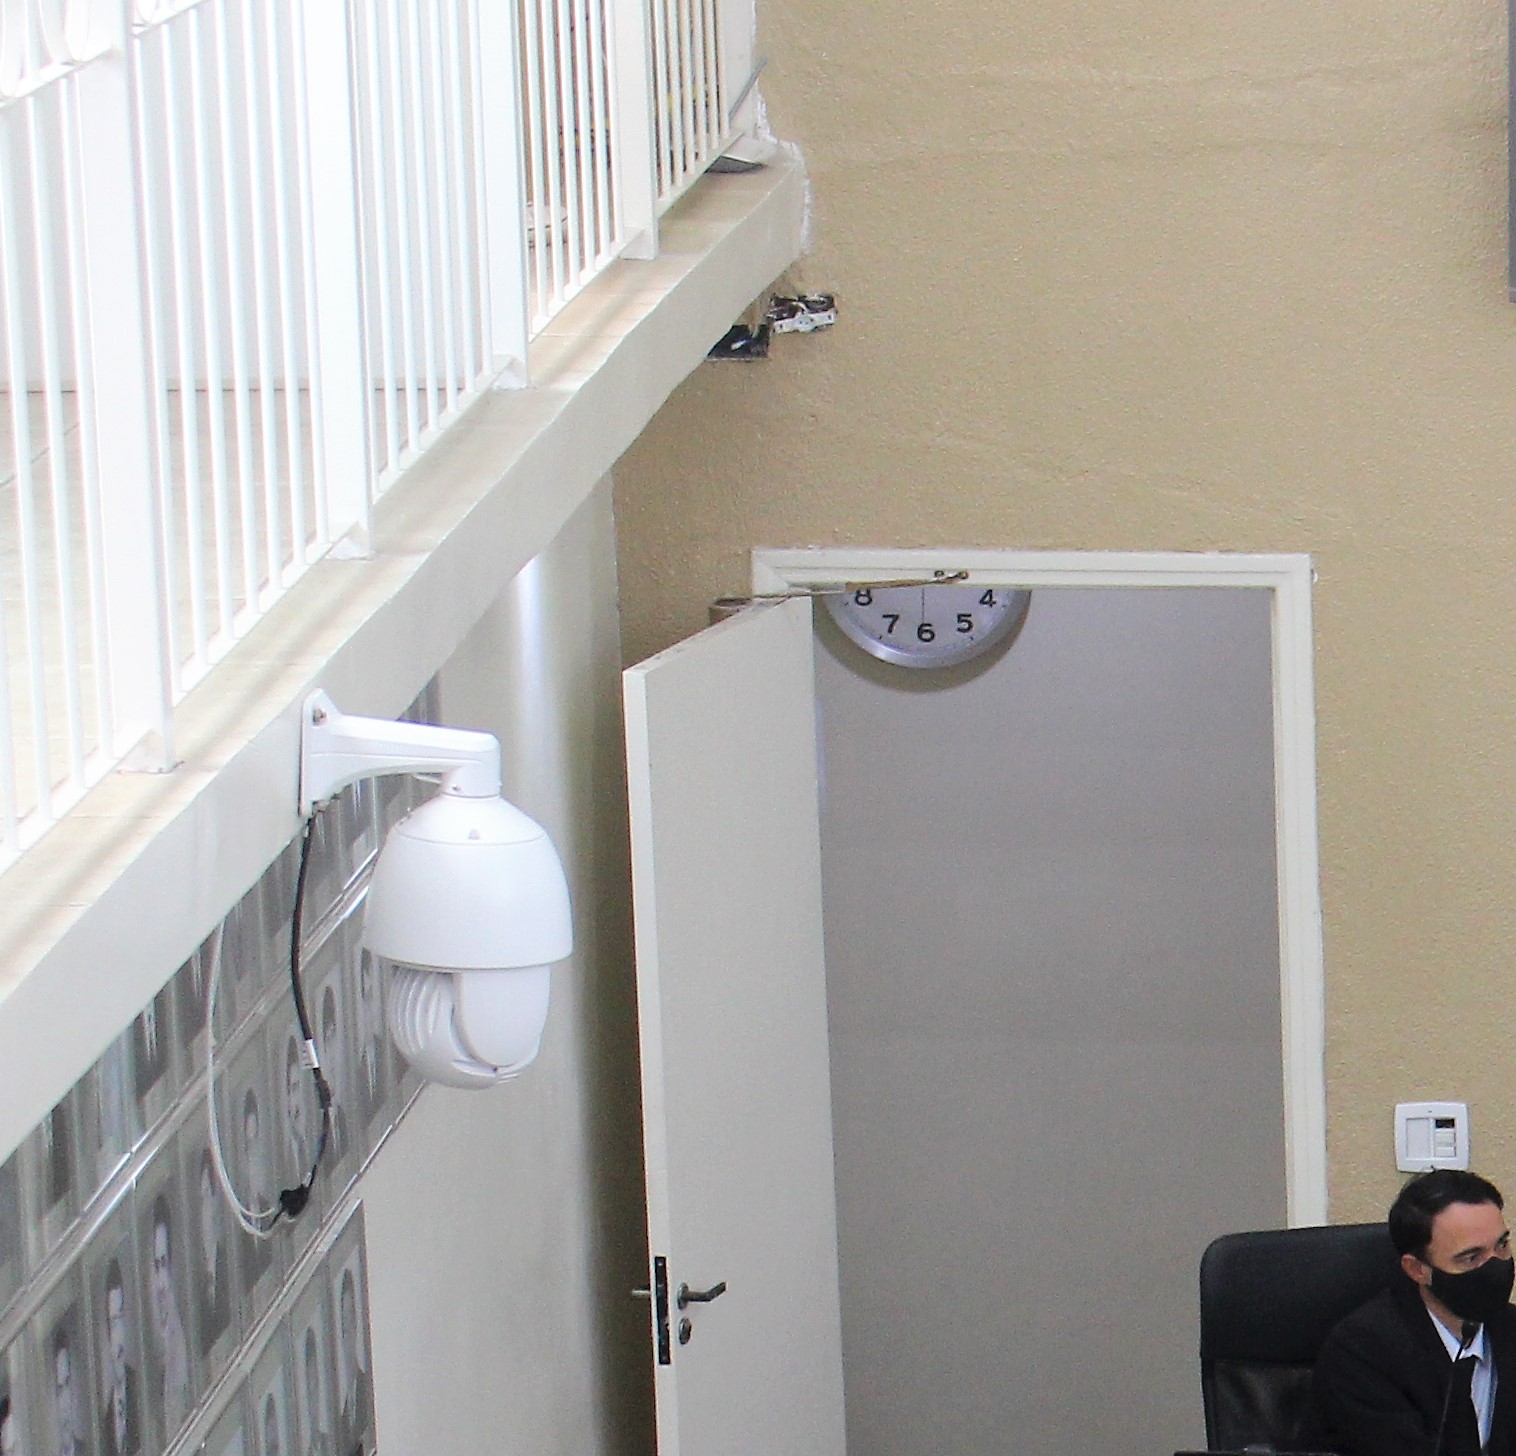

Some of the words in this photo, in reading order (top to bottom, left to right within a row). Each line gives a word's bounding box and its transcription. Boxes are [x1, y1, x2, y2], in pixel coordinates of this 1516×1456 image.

[978, 588, 997, 609] 4
[882, 613, 900, 634] 7
[916, 622, 936, 643] 6
[956, 613, 974, 633] 5
